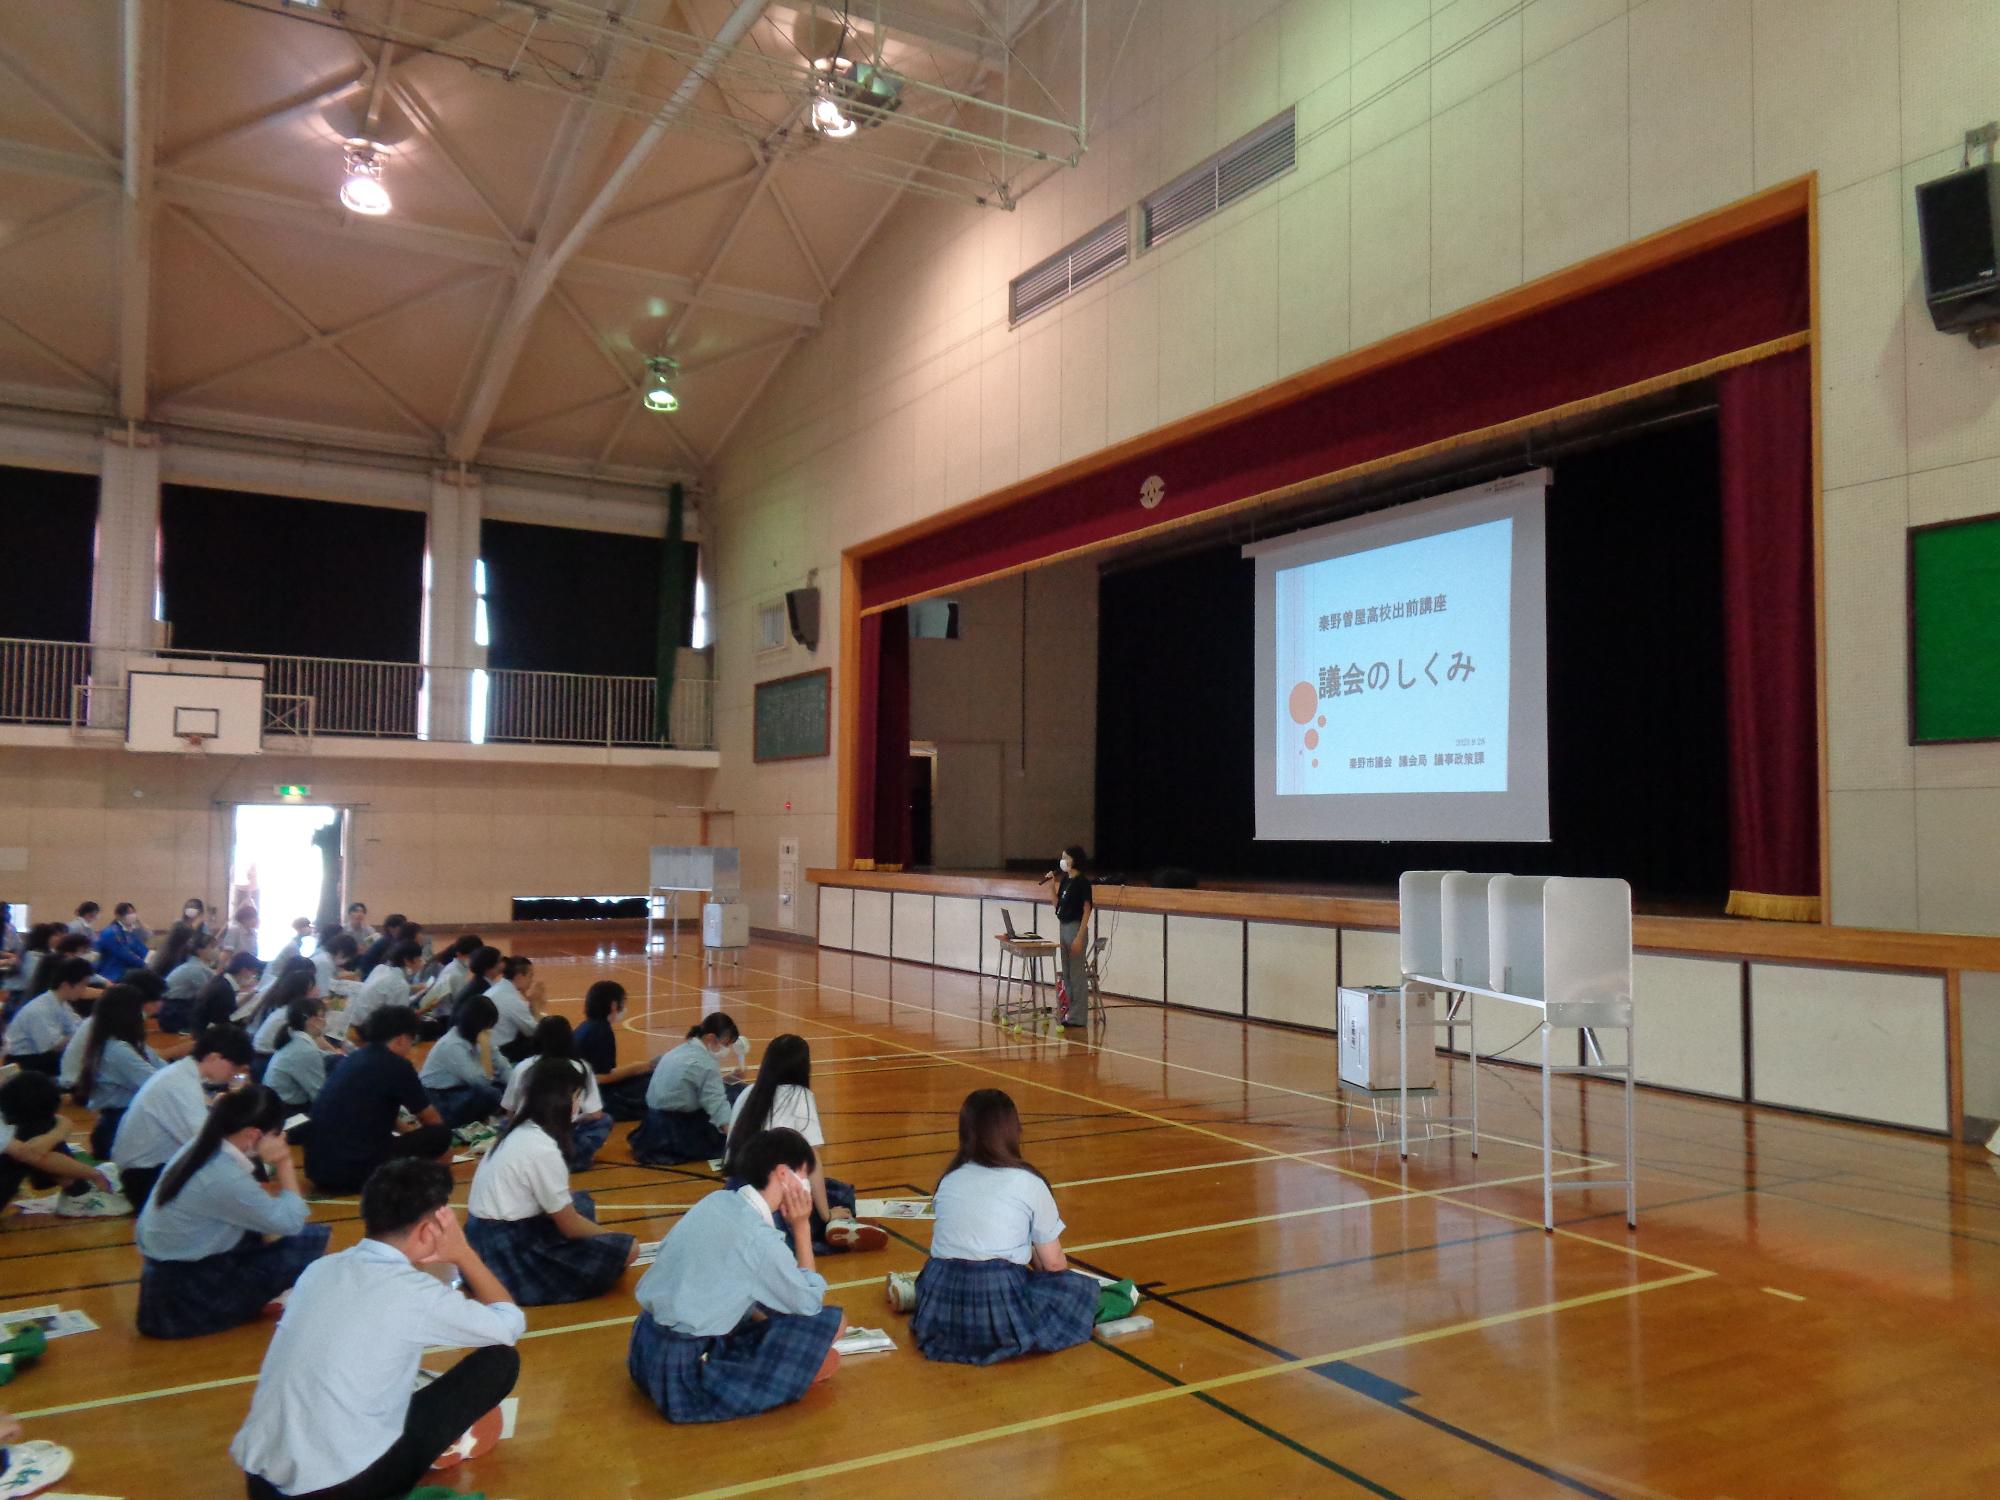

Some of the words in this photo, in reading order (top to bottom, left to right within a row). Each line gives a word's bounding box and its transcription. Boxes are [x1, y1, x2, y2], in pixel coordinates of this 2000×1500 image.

[1319, 651, 1475, 700] 議会のしくみ
